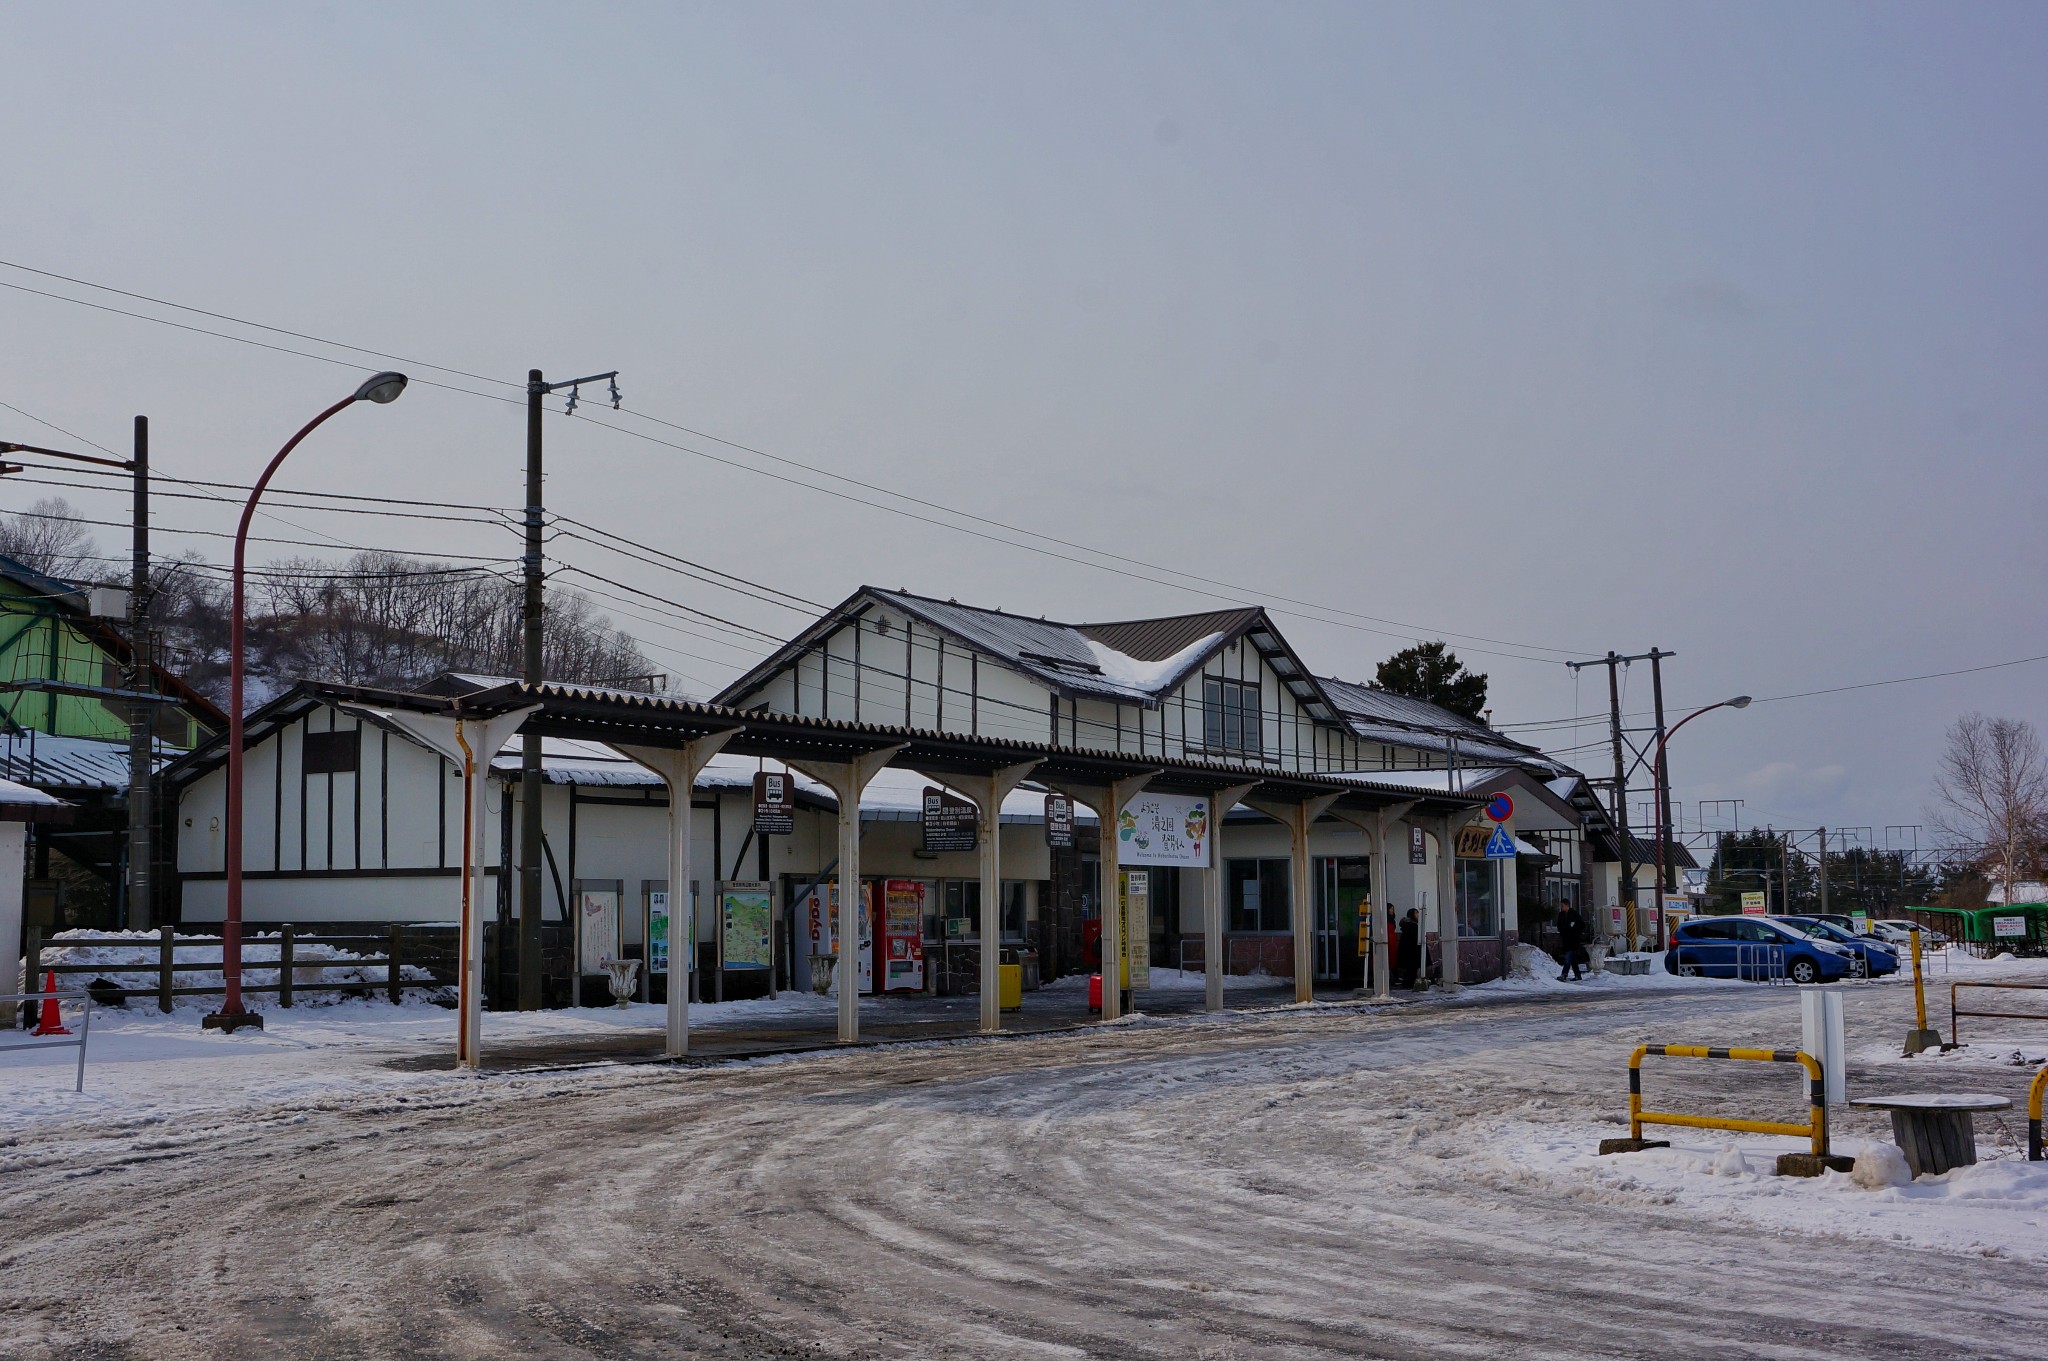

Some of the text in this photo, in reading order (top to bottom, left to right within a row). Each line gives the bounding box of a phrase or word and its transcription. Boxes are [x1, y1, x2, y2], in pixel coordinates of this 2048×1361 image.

[768, 778, 781, 788] Bus
[927, 797, 939, 805] Bus
[1055, 801, 1065, 810] Bus
[1140, 801, 1160, 815] ようこそ
[811, 897, 823, 941] DyDo
